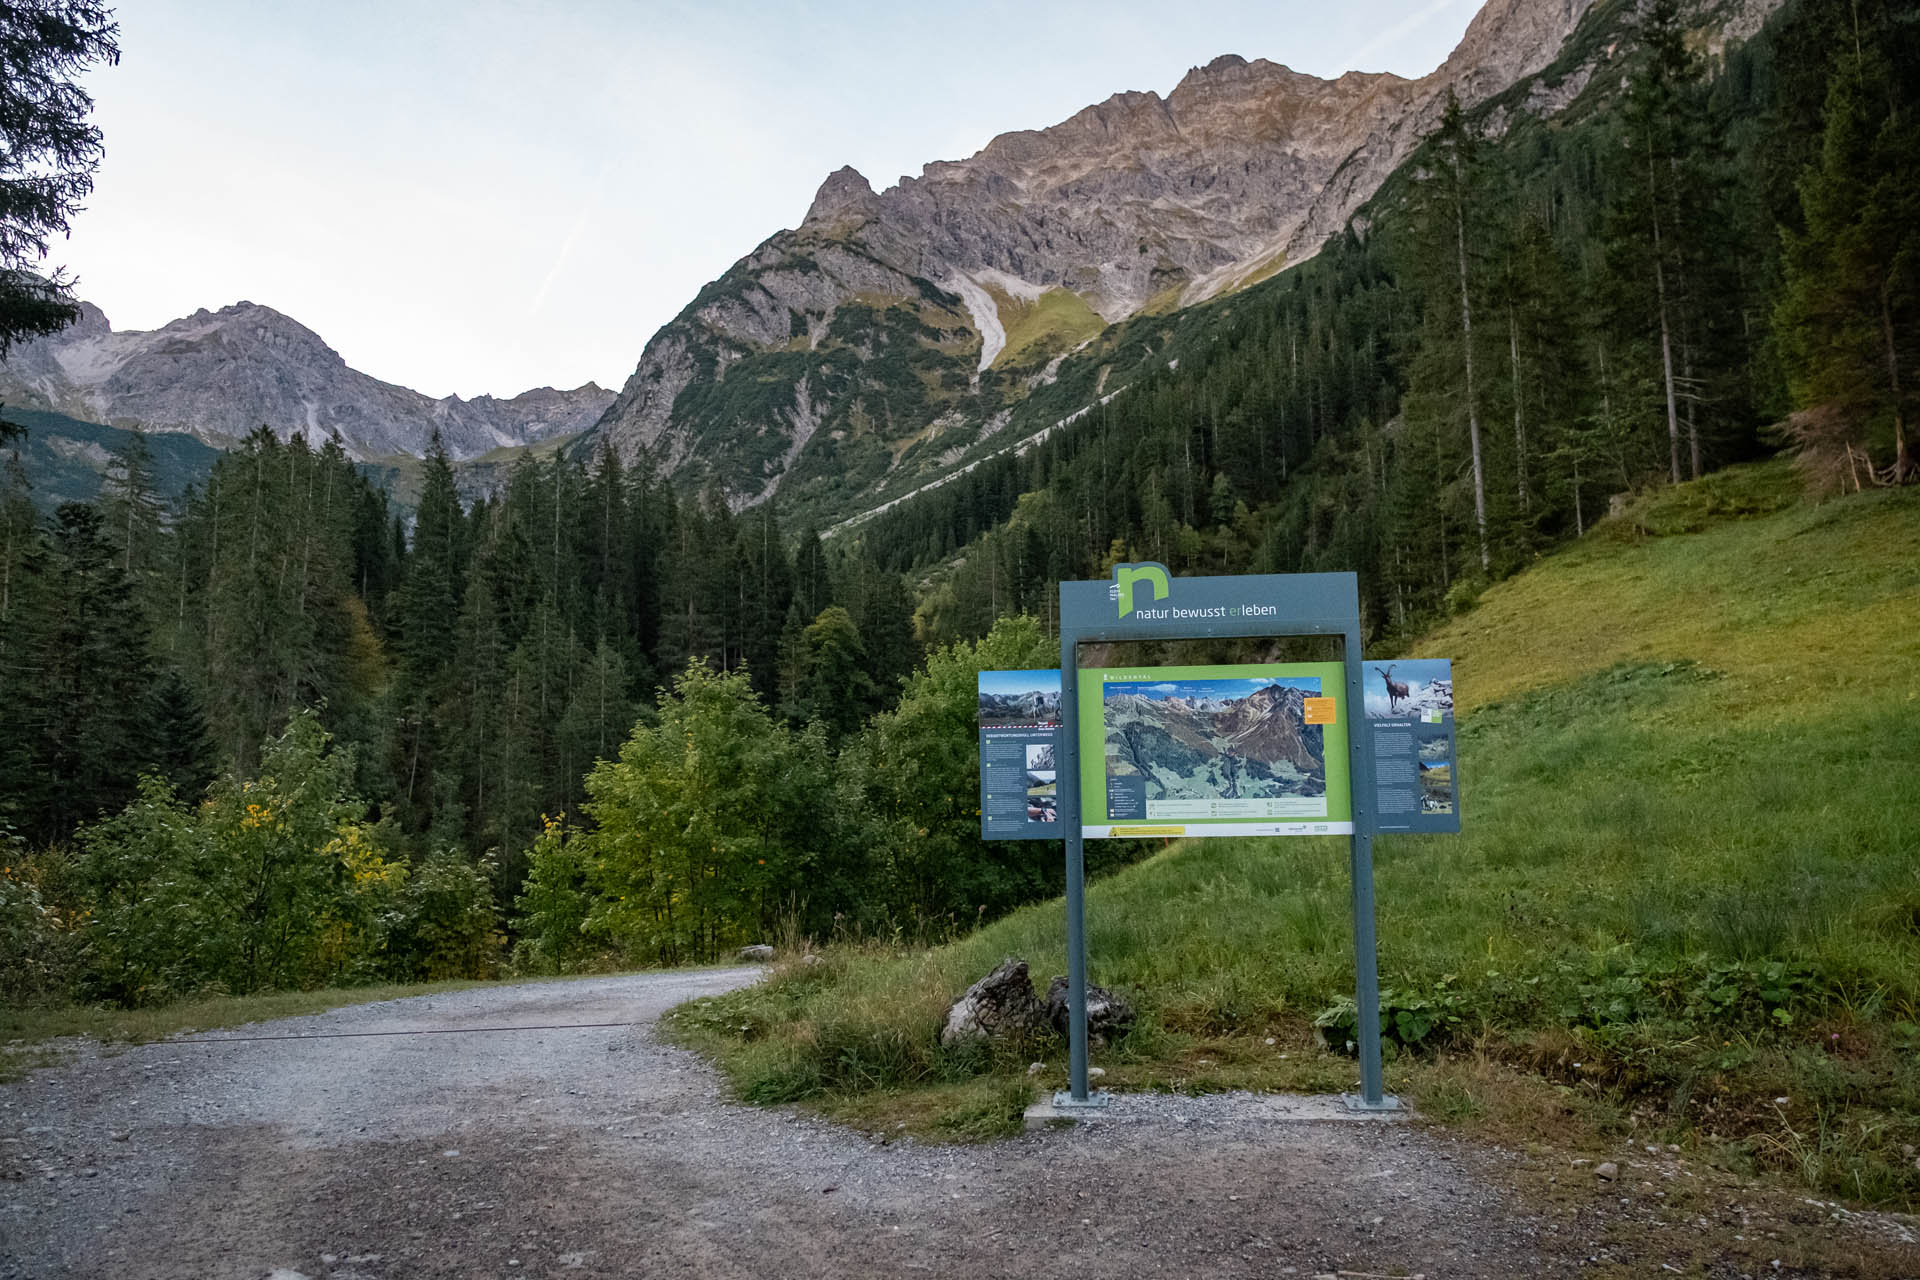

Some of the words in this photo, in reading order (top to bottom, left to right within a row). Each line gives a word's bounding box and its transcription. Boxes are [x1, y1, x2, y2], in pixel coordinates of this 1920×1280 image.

[1136, 607, 1169, 620] natur
[1172, 606, 1226, 619] bewusst
[1229, 604, 1277, 617] erleben
